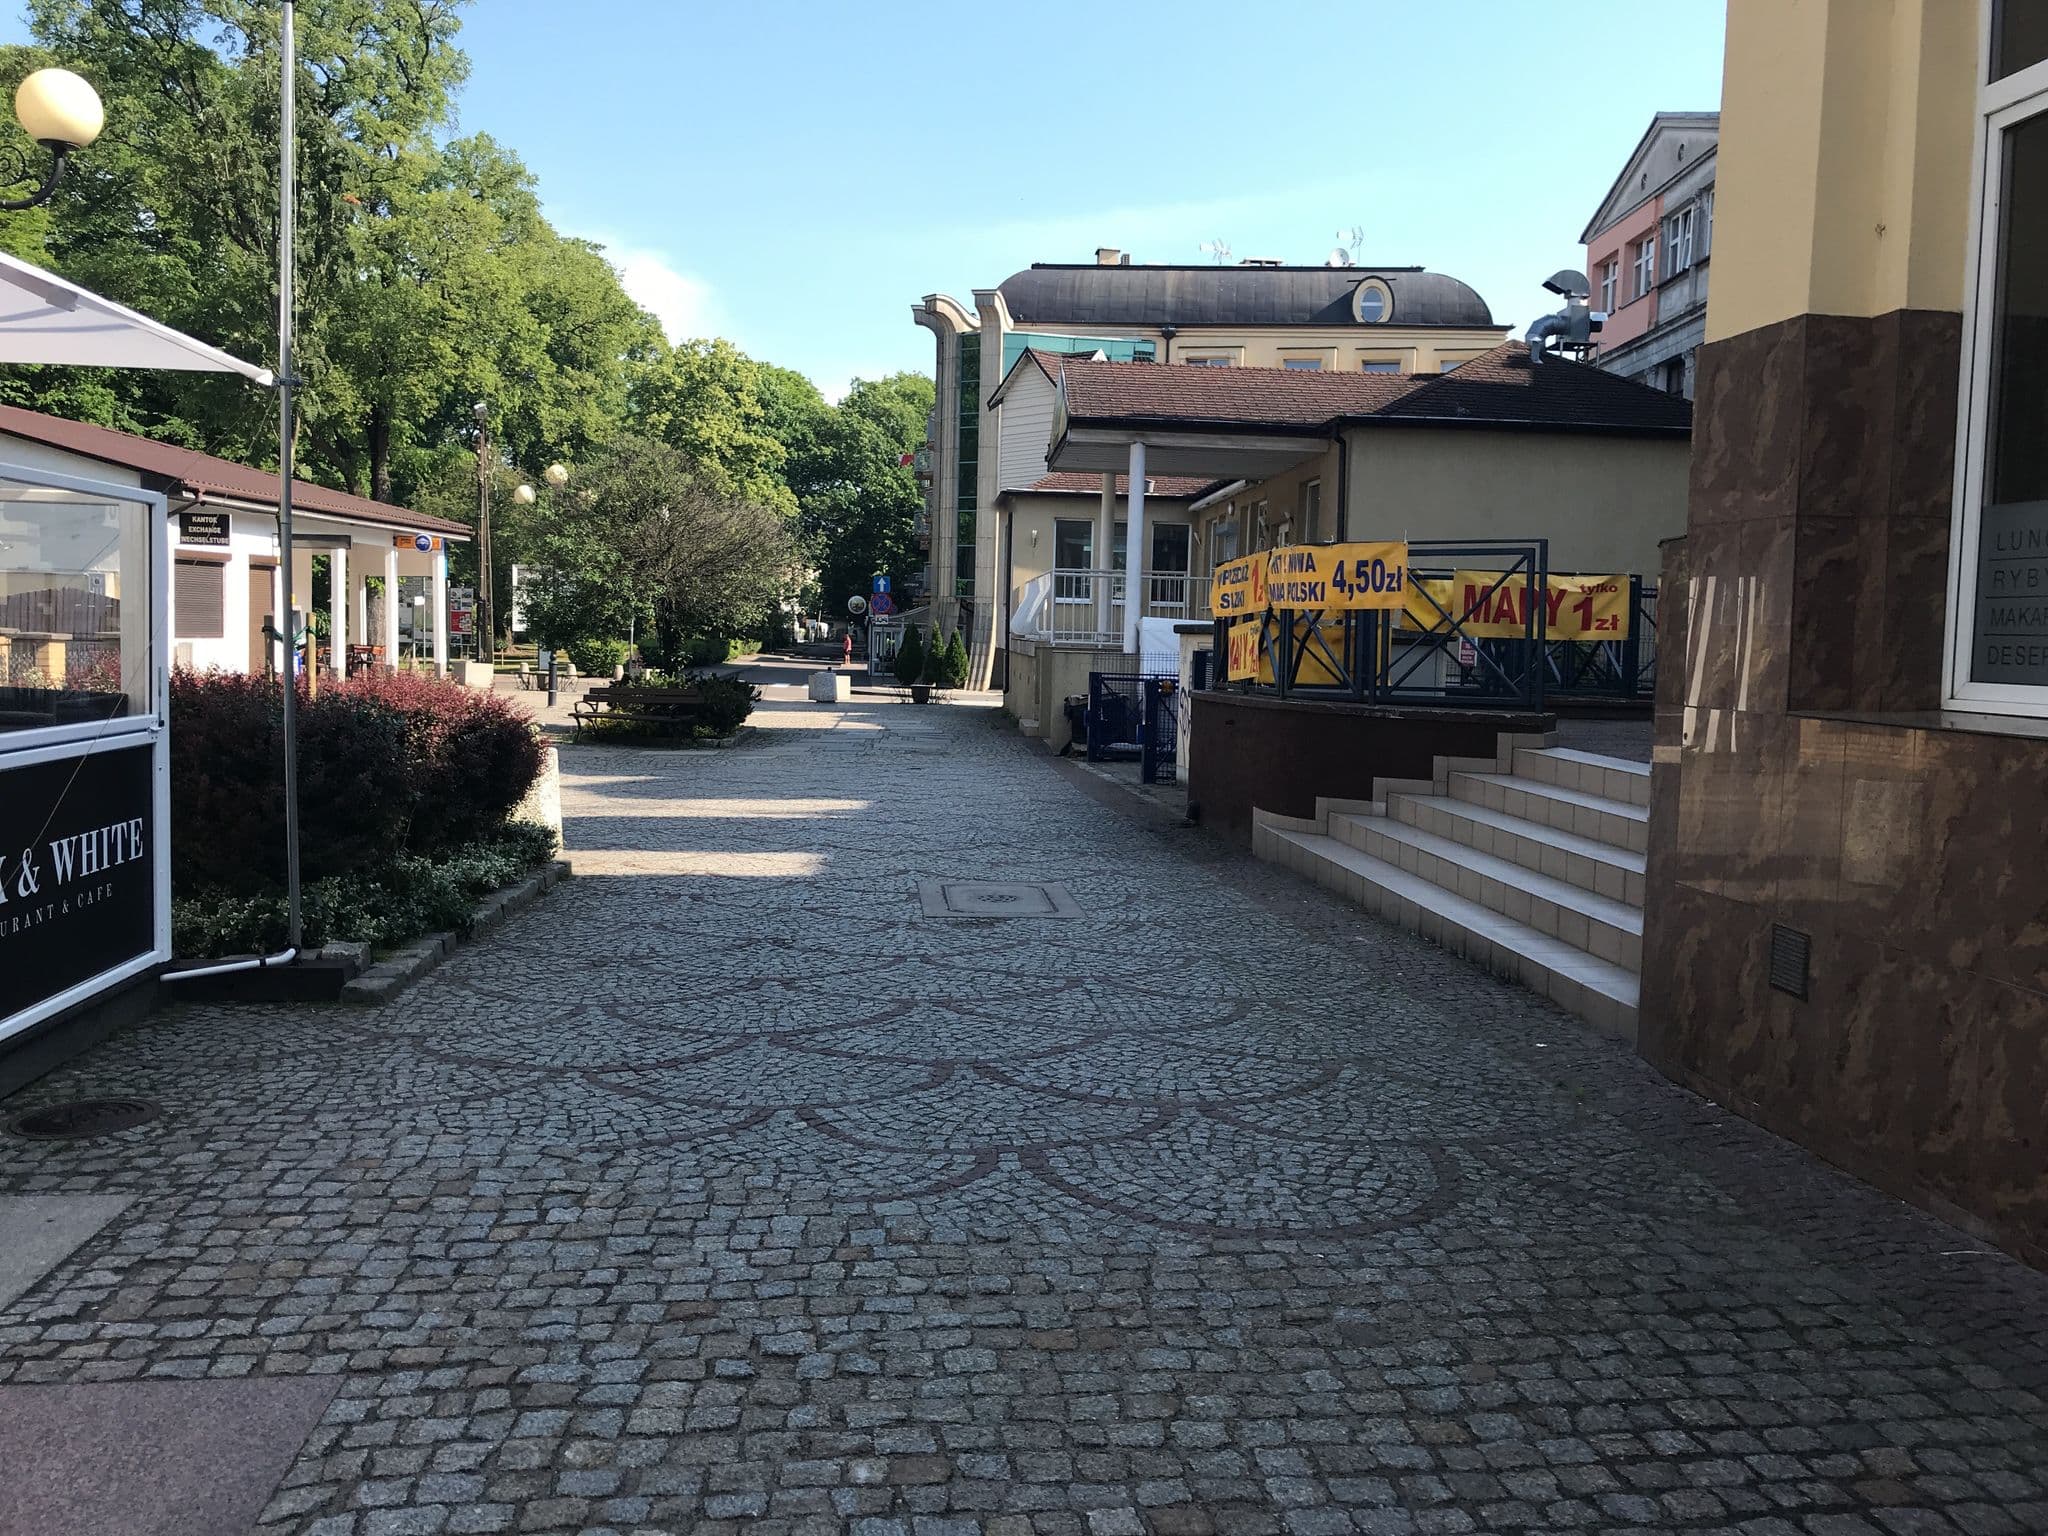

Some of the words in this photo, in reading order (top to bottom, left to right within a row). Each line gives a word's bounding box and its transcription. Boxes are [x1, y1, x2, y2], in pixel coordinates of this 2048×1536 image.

[192, 516, 218, 524] KANTOR
[188, 526, 222, 534] EXCHANGE
[180, 536, 230, 545] WECHSELSTUBE
[1332, 558, 1403, 601] 4,50zł
[1287, 580, 1326, 603] POLSKI
[1580, 583, 1618, 596] tylko
[18, 847, 41, 898] &
[49, 817, 144, 886] WHITE
[77, 883, 113, 908] CAFE
